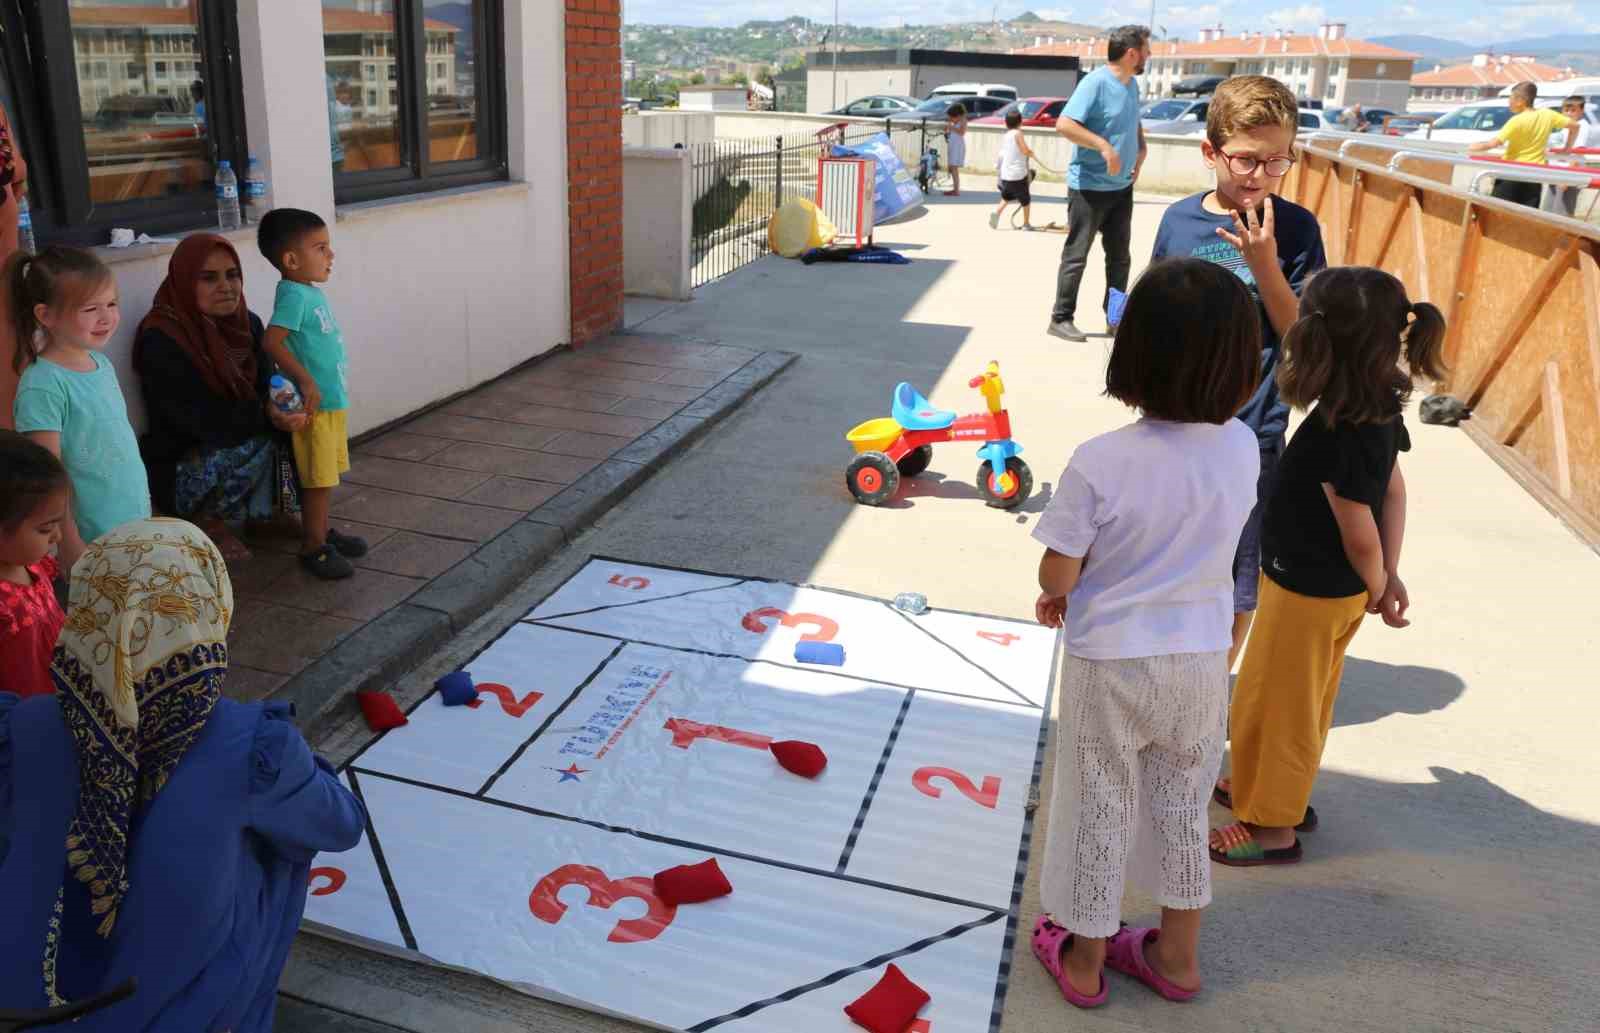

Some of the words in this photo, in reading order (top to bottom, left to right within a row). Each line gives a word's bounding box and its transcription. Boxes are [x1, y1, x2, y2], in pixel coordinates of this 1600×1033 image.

[607, 573, 650, 591] 5
[741, 606, 839, 643] 3
[976, 629, 1020, 647] 4
[467, 682, 545, 718] 2
[663, 716, 774, 751] 1
[910, 766, 1003, 809] 2
[528, 862, 678, 944] 3
